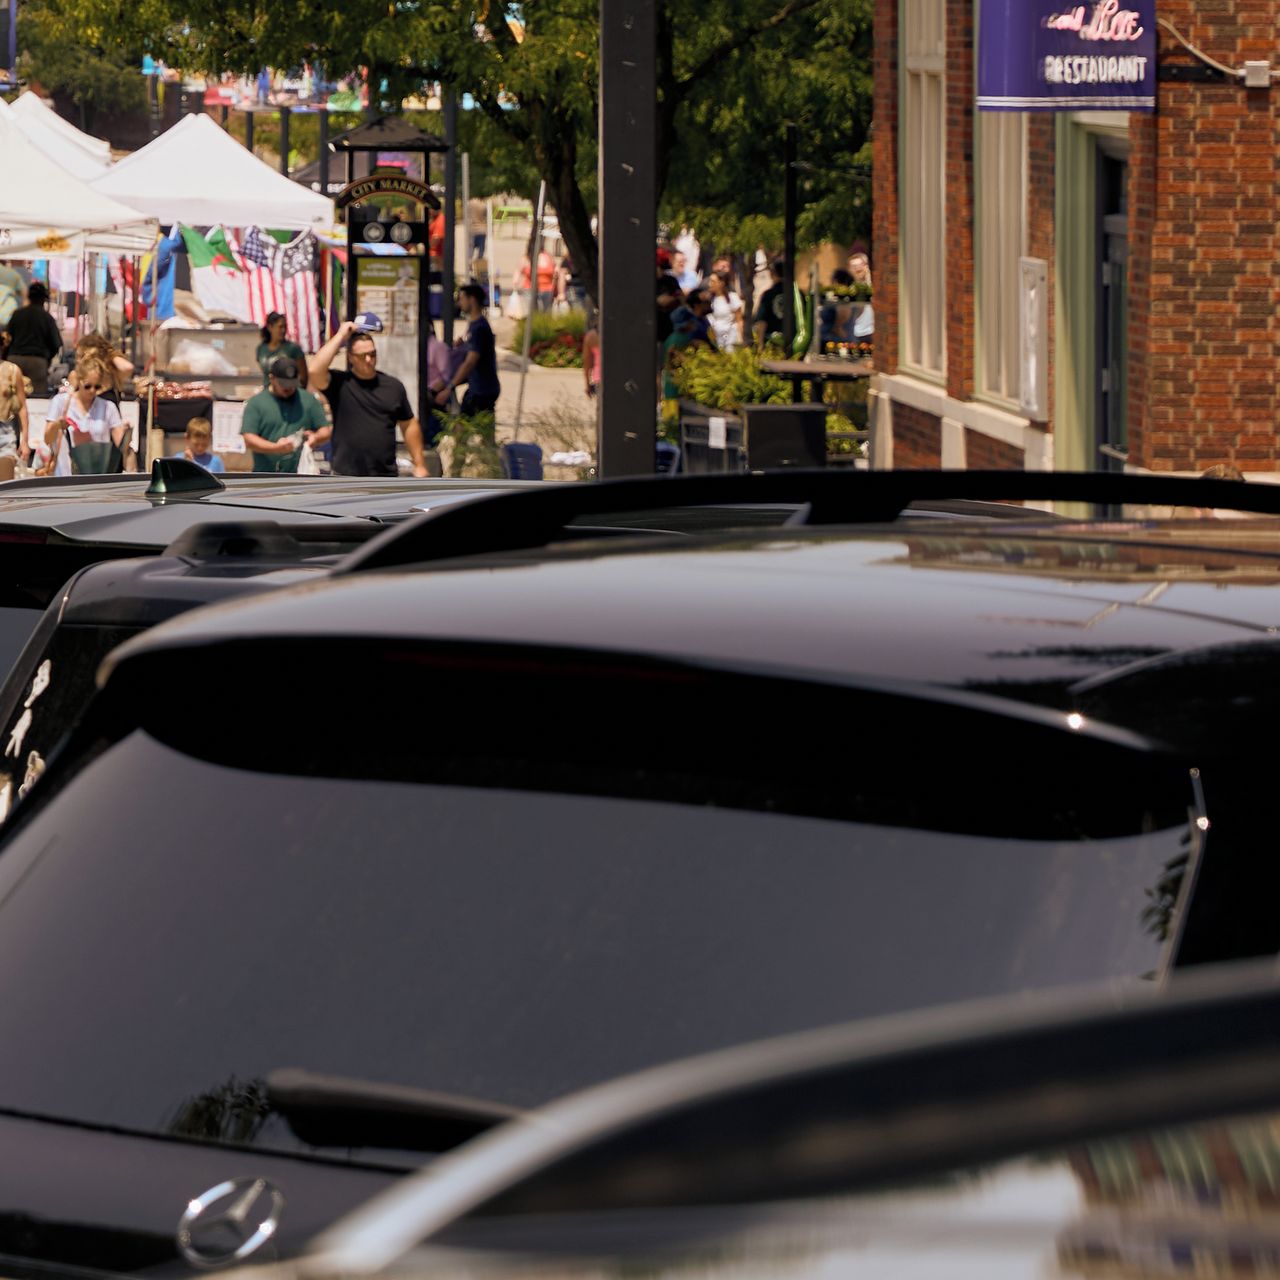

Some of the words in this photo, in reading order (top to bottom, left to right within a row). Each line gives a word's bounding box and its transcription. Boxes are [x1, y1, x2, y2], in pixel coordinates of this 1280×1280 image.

[1044, 55, 1148, 84] RESTAURANT
[351, 182, 377, 198] CITY
[379, 179, 427, 197] MARKET
